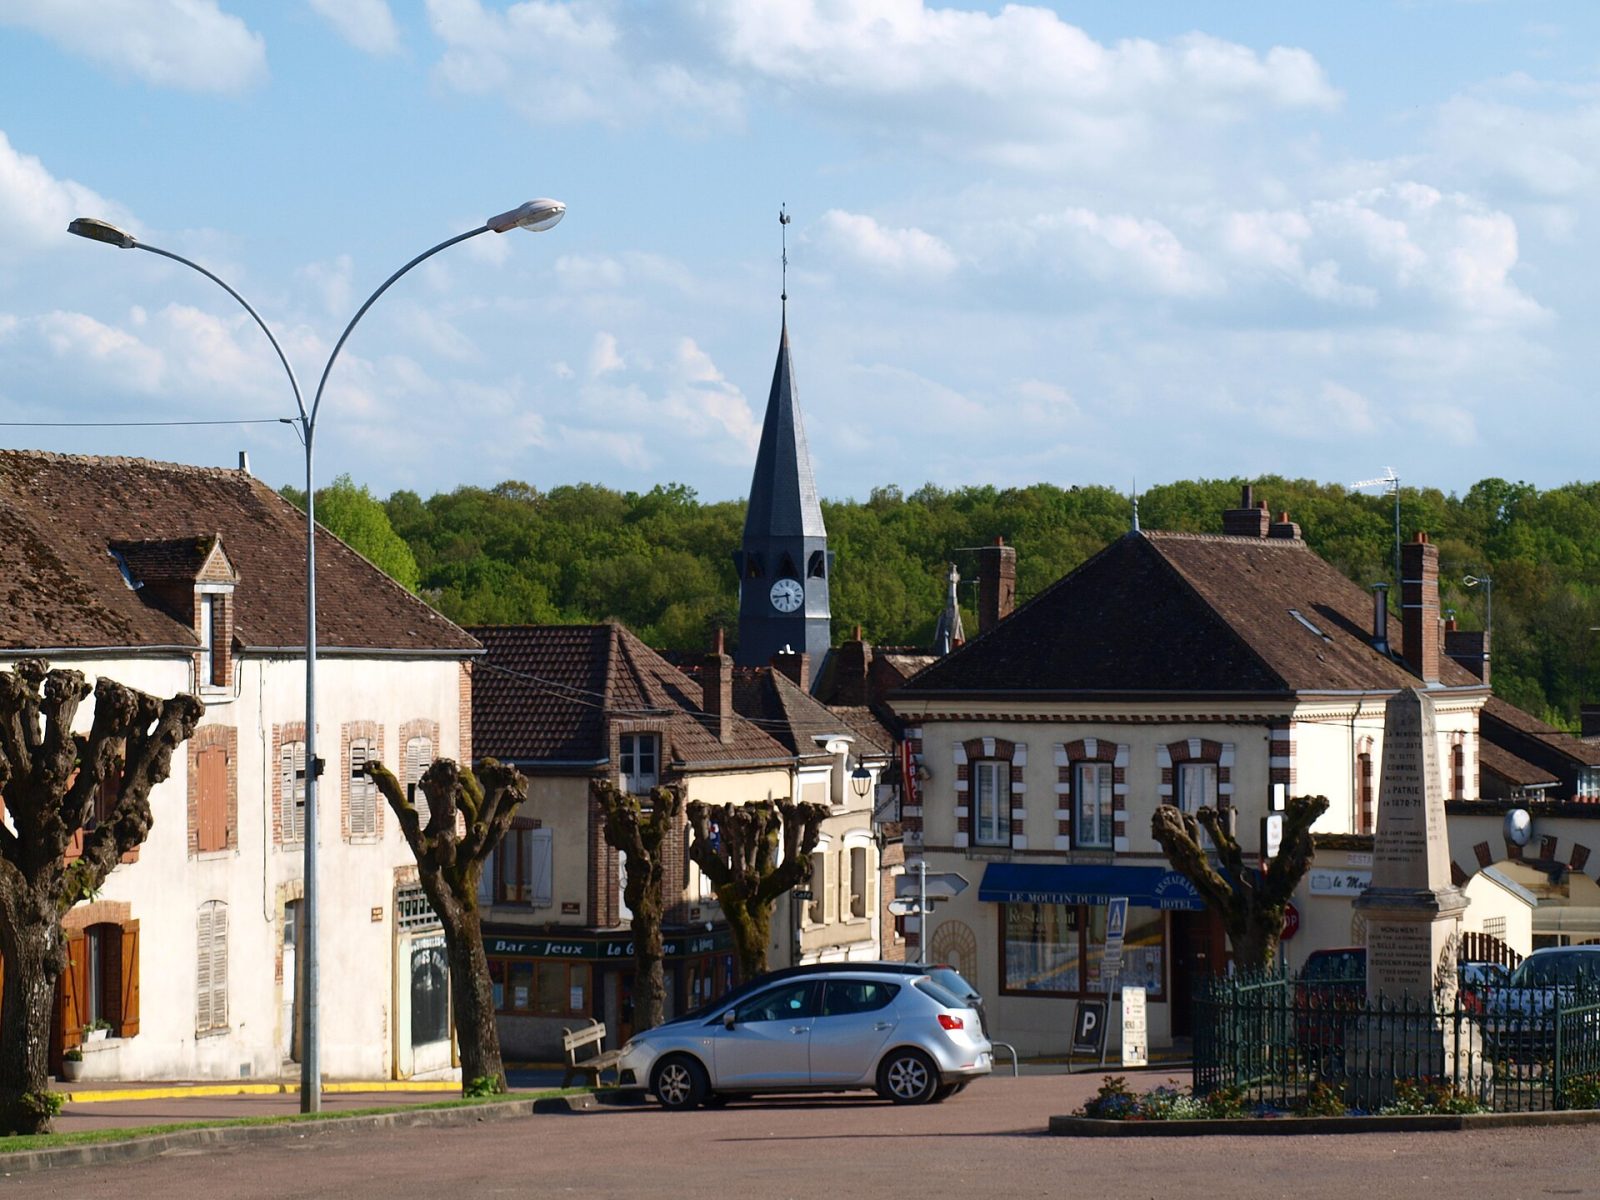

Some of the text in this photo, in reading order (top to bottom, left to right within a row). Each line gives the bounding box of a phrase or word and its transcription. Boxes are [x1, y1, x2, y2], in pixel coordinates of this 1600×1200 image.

[907, 742, 917, 799] TABAC
[1392, 786, 1420, 795] PATRIE
[1391, 799, 1421, 807] 1870-71
[1009, 893, 1024, 903] LE
[1028, 893, 1071, 904] MOULIN
[1077, 895, 1094, 905] DU
[1160, 899, 1193, 909] HOTEL
[495, 940, 525, 952] Bar
[544, 942, 583, 955] Jeux
[607, 942, 621, 956] Le
[1082, 1011, 1096, 1037] P
